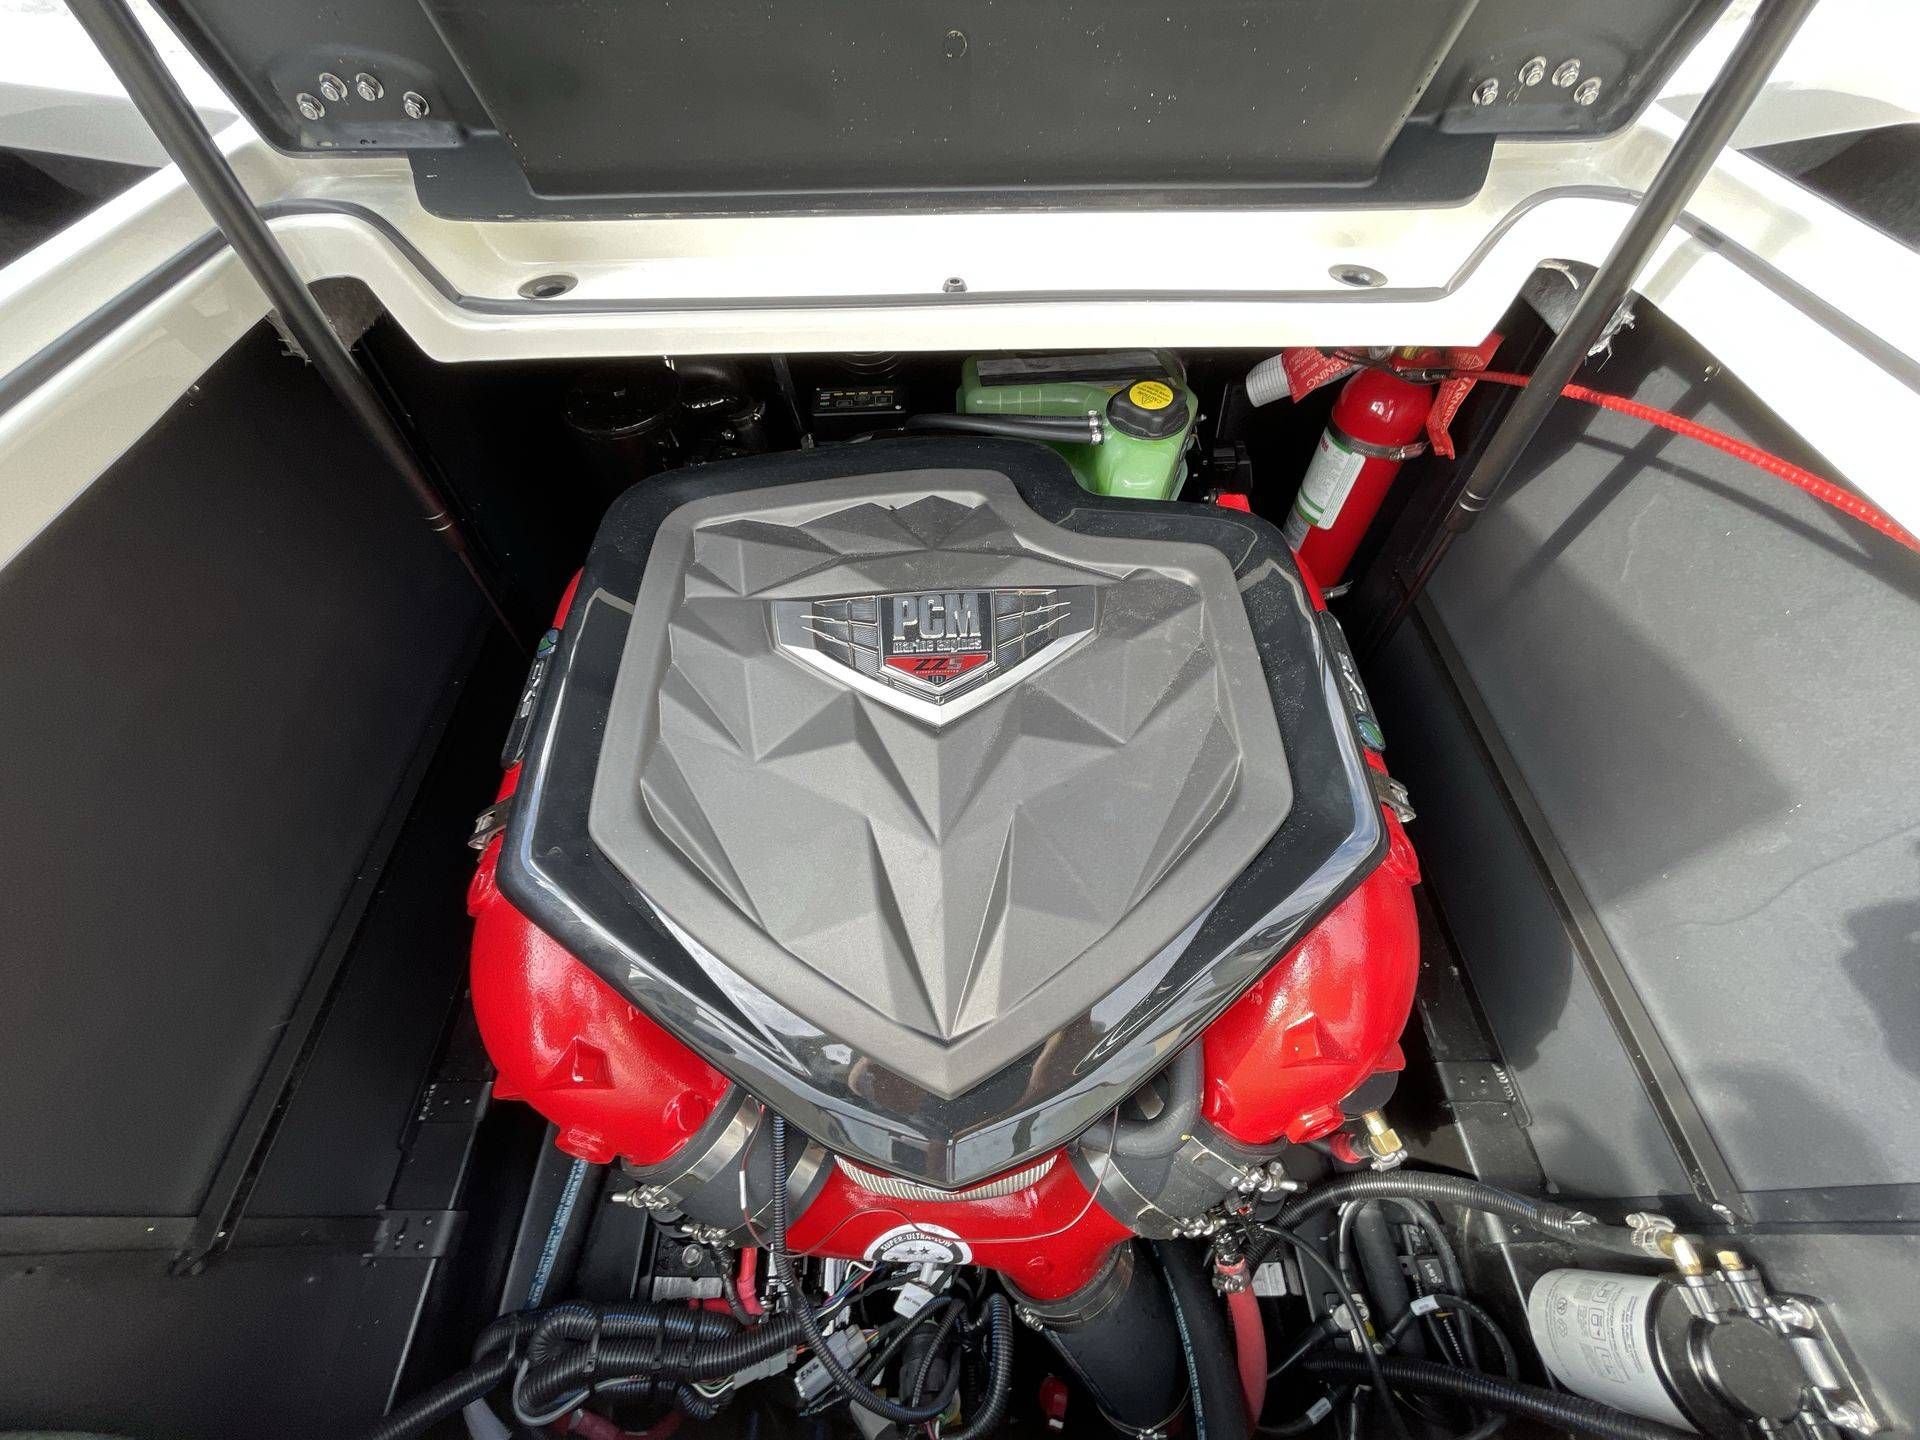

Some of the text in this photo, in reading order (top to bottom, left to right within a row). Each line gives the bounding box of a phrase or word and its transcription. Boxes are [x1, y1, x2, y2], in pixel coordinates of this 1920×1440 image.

[1306, 358, 1348, 390] ARNING
[893, 592, 981, 640] PCM
[893, 637, 982, 653] marine engines
